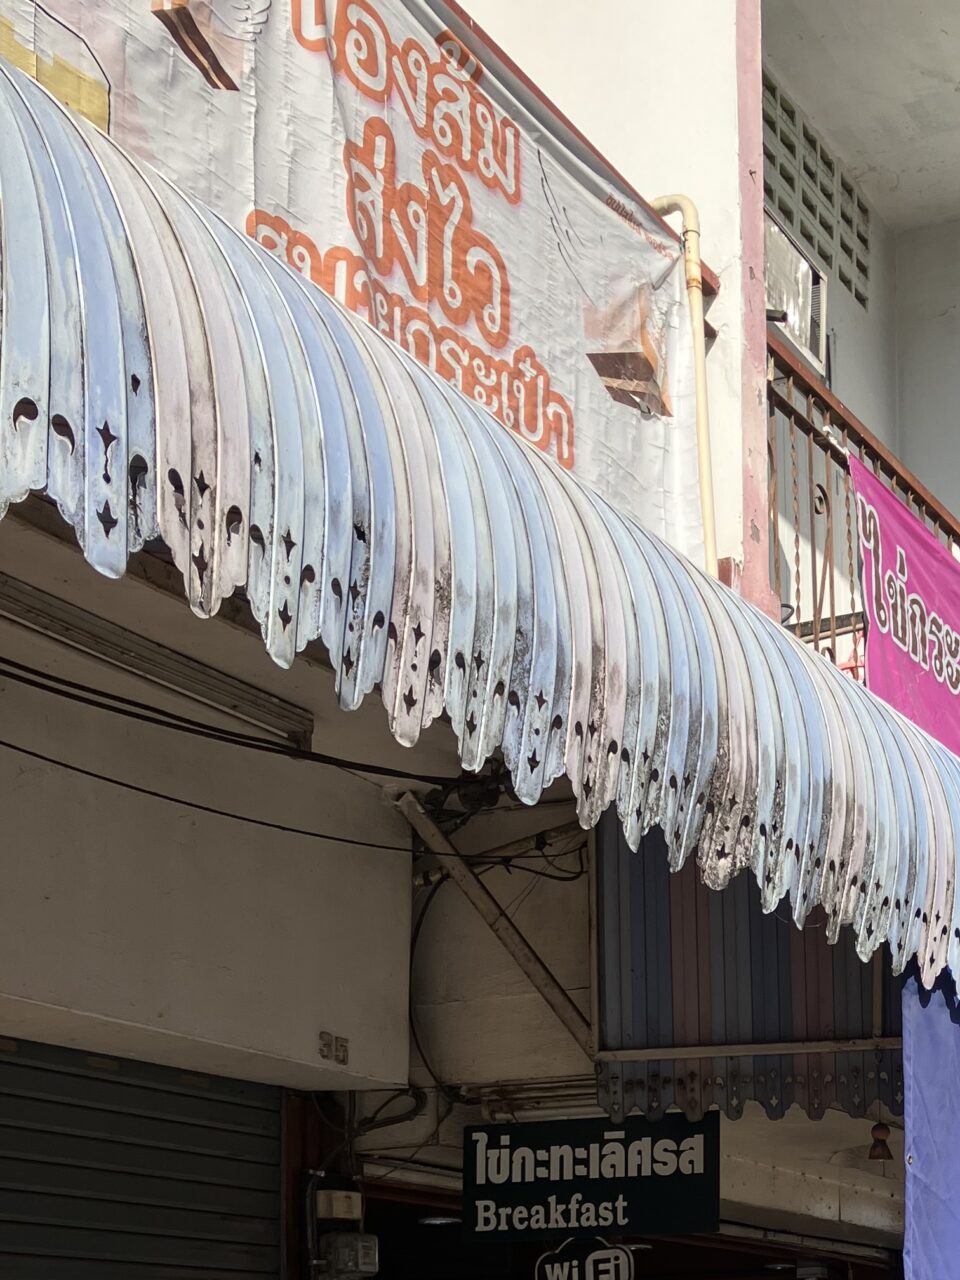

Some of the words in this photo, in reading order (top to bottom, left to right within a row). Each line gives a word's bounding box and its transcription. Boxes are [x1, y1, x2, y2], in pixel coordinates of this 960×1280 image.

[349, 134, 502, 334] ส่งไว
[318, 1030, 350, 1066] 35
[474, 1193, 630, 1233] Breakfast
